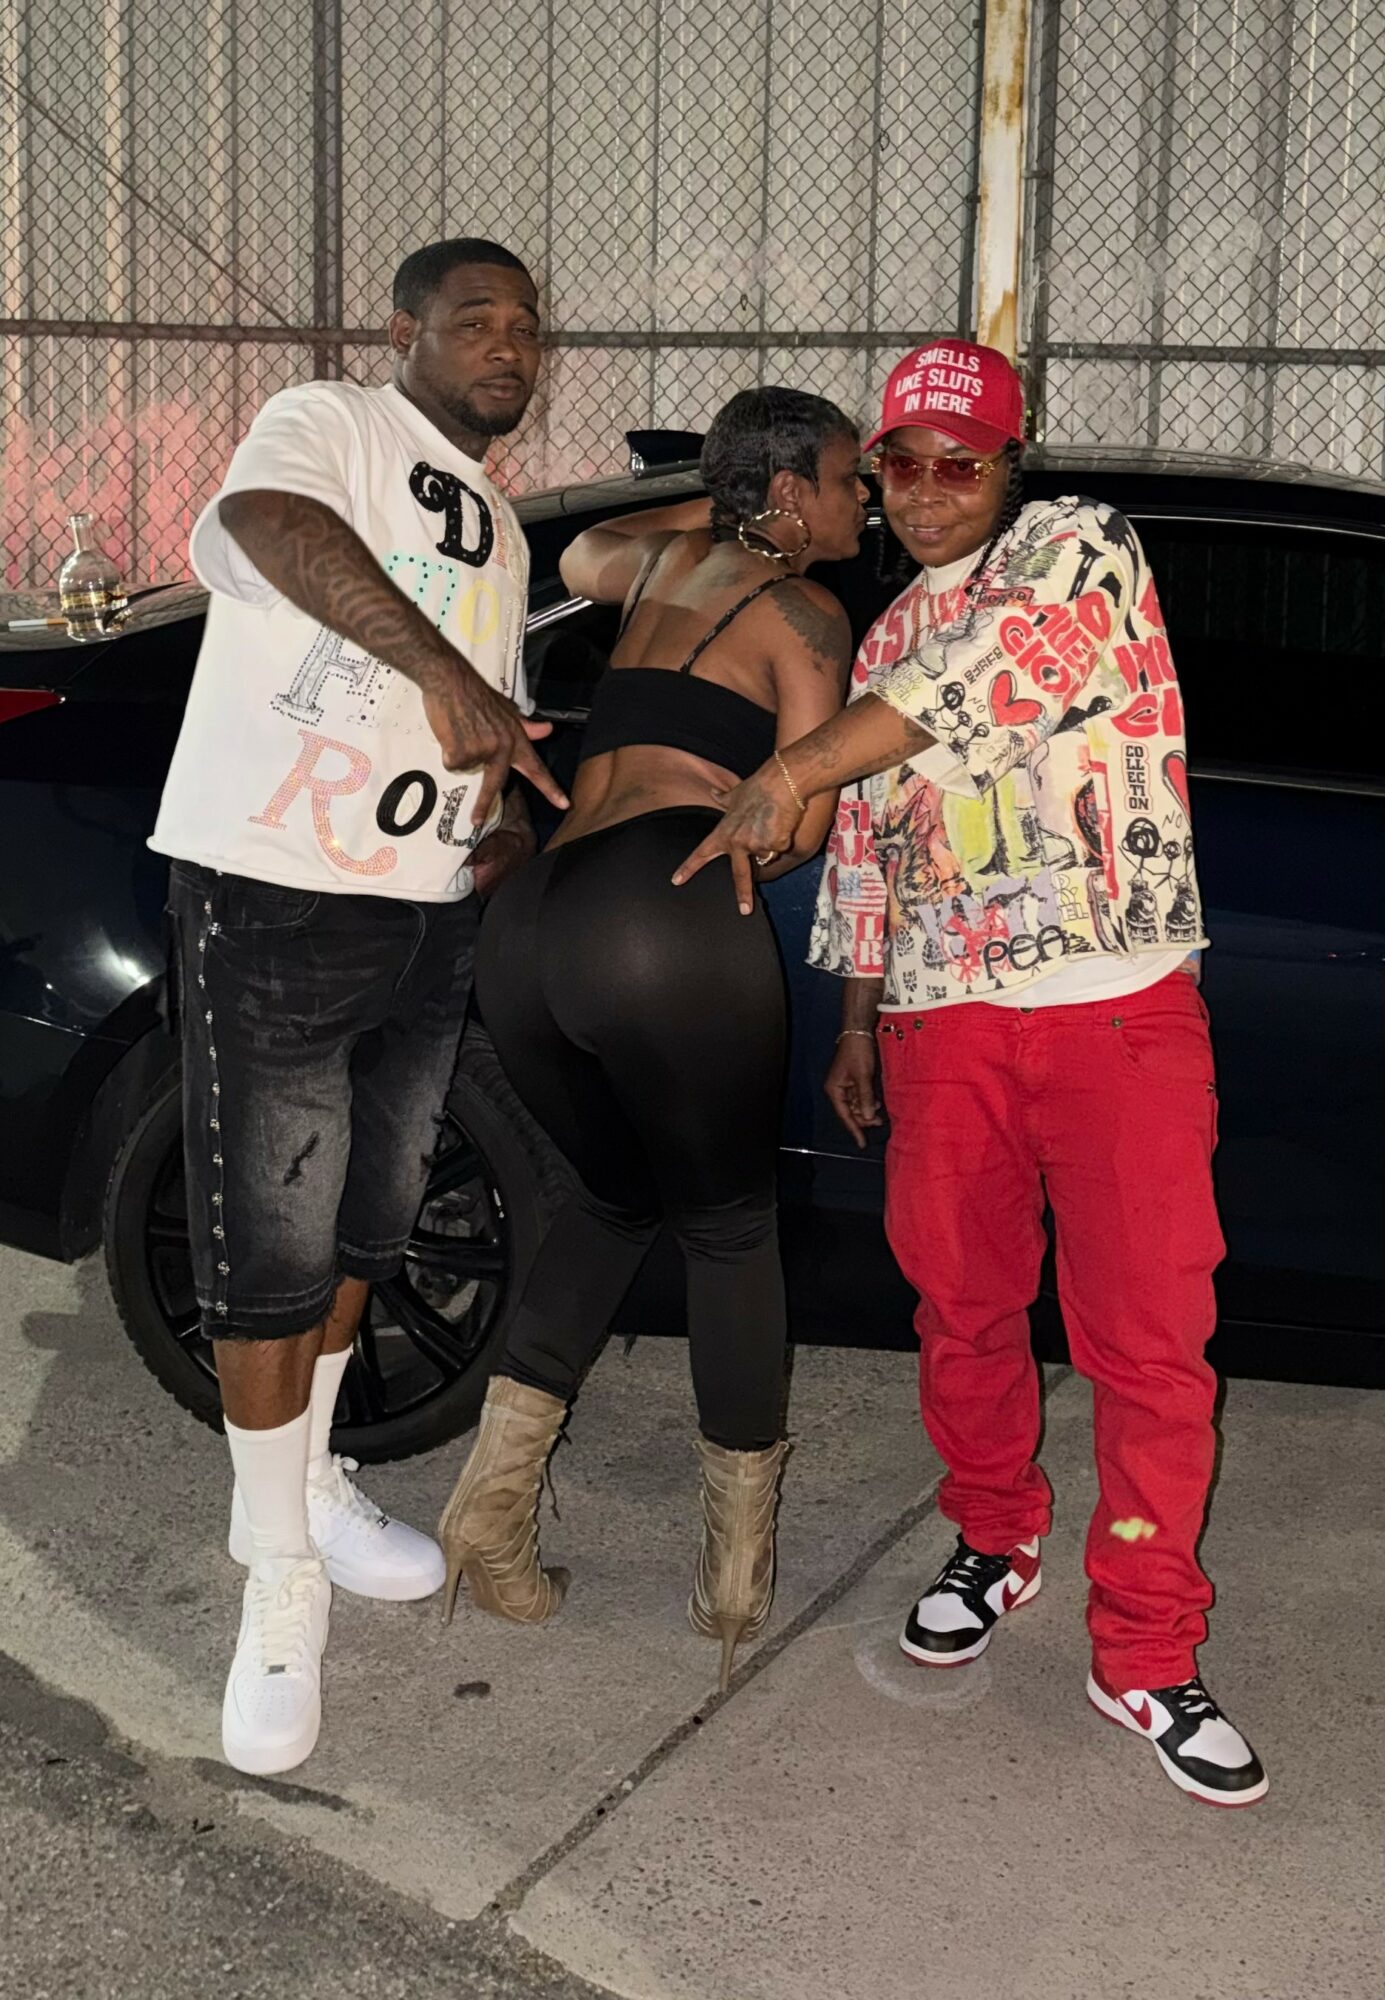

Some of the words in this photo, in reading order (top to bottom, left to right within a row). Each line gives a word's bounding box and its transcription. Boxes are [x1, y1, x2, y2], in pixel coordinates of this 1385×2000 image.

[915, 347, 981, 373] SMELLS
[895, 370, 925, 398] LIKE
[927, 368, 983, 397] SLUTS
[904, 392, 922, 413] IN
[924, 391, 974, 417] HERE
